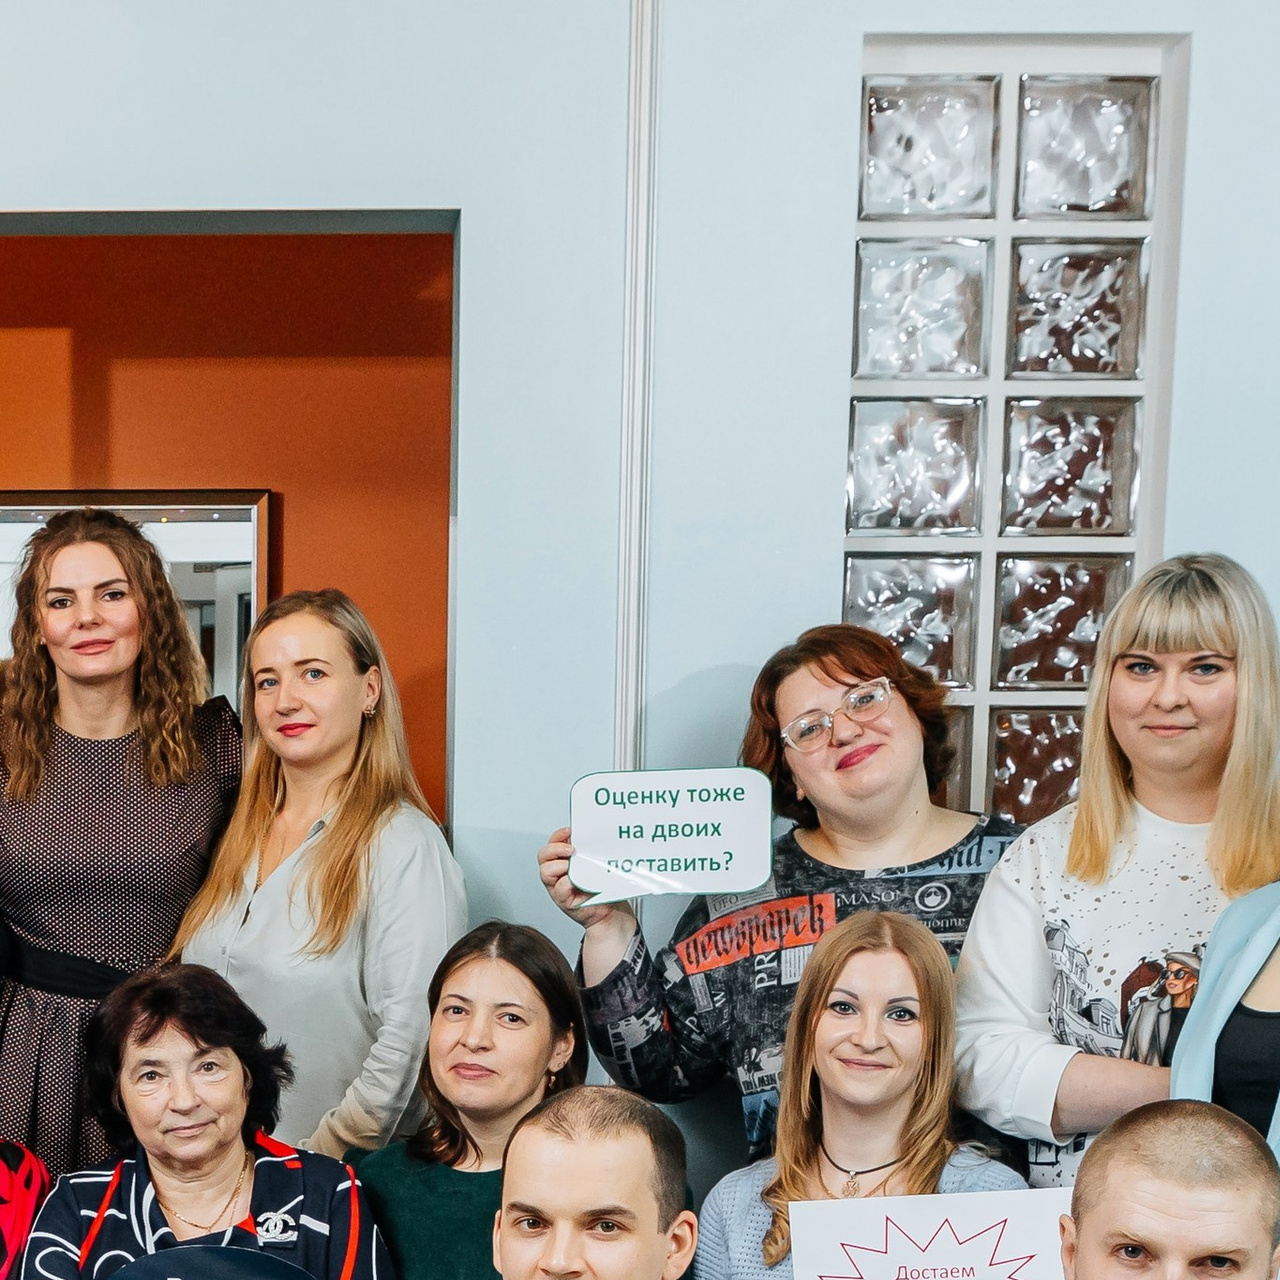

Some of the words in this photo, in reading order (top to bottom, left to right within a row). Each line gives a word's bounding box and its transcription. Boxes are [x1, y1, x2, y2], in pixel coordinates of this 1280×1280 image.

[594, 787, 680, 809] Оценку
[686, 786, 745, 803] тоже
[618, 824, 644, 839] на
[651, 821, 722, 843] двоих
[607, 851, 734, 873] поставить?
